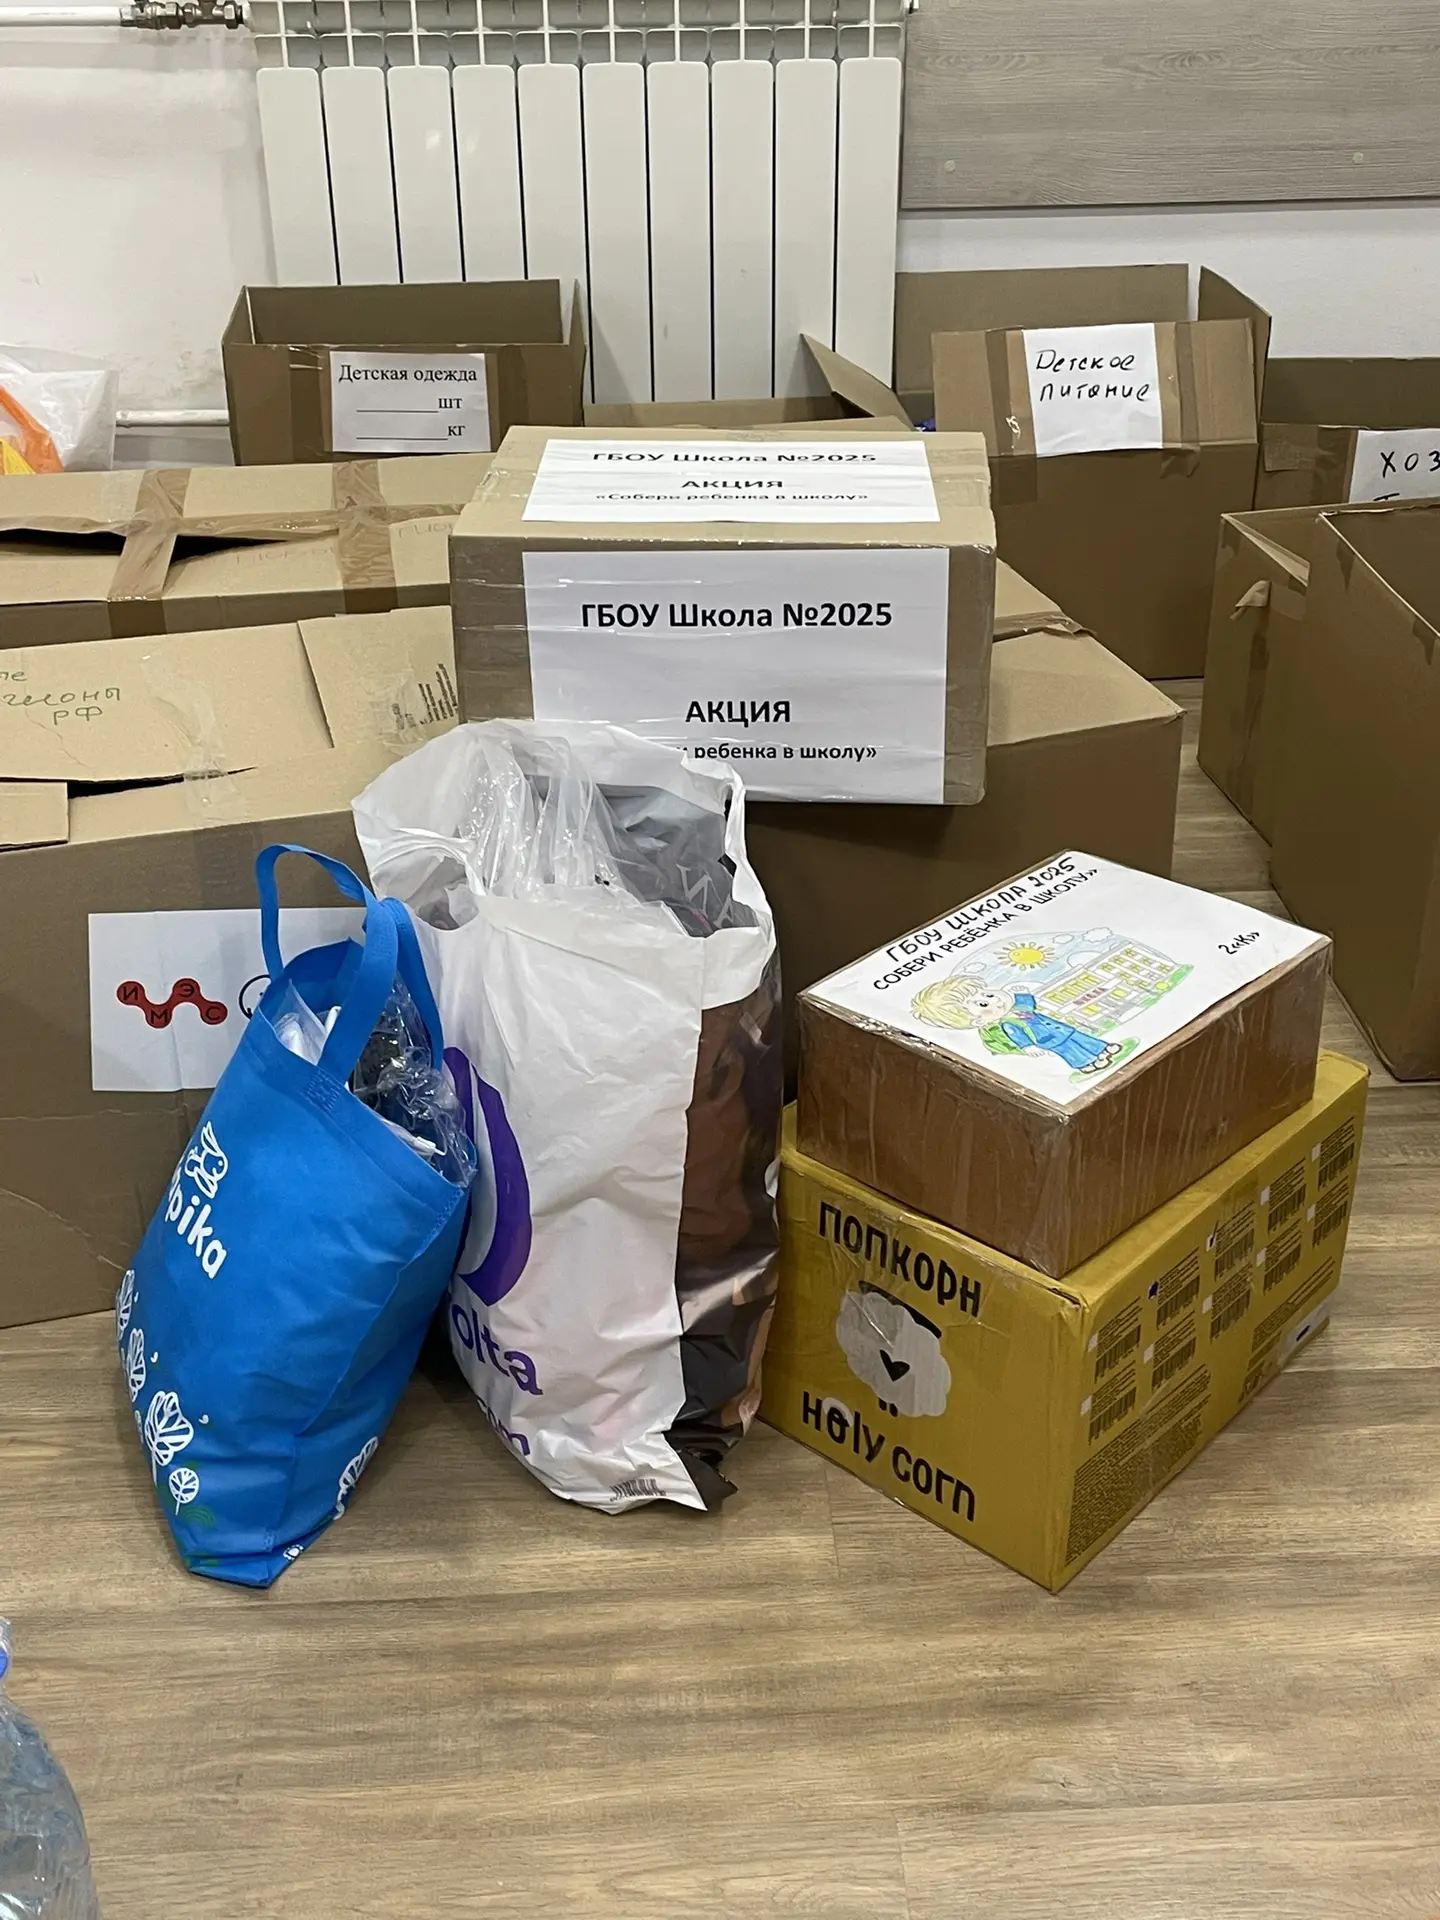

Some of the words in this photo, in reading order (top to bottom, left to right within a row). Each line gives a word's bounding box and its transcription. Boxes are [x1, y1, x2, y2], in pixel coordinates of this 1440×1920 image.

[1035, 348, 1135, 373] Детское
[338, 364, 408, 382] Детская
[413, 367, 478, 382] одежда
[593, 452, 664, 462] ГБОУ
[673, 453, 768, 462] Школа
[777, 453, 877, 462] №2025
[681, 479, 783, 490] АКЦИЯ
[686, 493, 769, 501] ребенка
[581, 603, 660, 628] ГБОУ
[668, 603, 773, 628] Школа
[782, 601, 893, 628] №2025
[53, 705, 103, 726] РФ
[685, 700, 792, 728] АКЦИЯ
[693, 742, 777, 760] ребенка
[783, 747, 795, 759] в
[799, 746, 878, 763] школу»
[886, 928, 943, 962] ГБОУ
[945, 884, 1028, 931] ШКОЛА
[1027, 856, 1076, 888] 2025
[872, 951, 944, 991] СОБЕРИ
[939, 911, 1019, 953] РЕБЁНКА
[1013, 903, 1033, 913] В
[165, 1165, 228, 1280] pika
